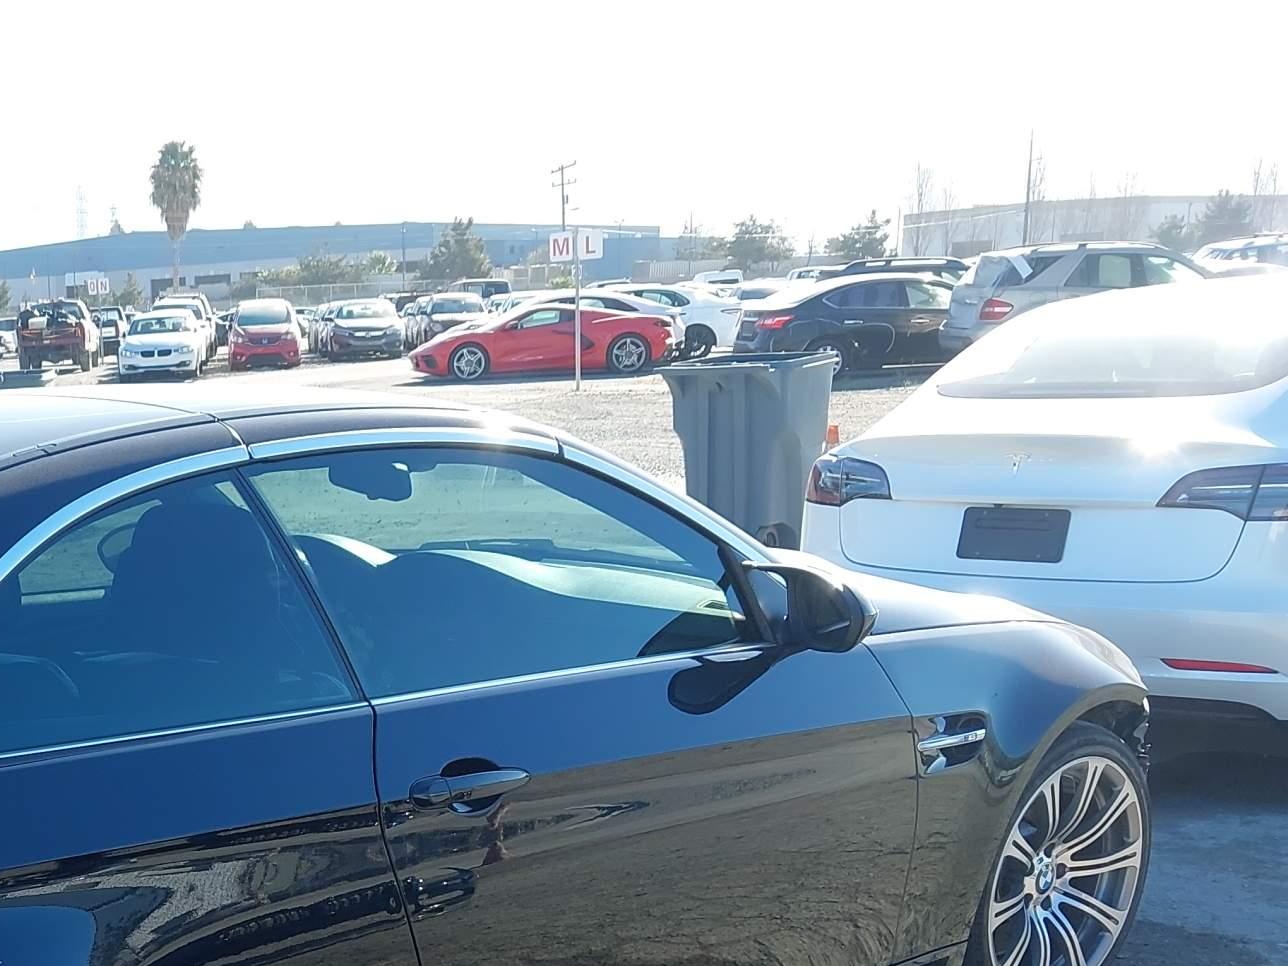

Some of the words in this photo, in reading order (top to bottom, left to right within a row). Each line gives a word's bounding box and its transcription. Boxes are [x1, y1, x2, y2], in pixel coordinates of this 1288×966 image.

[552, 237, 570, 257] M
[585, 235, 596, 255] L
[100, 280, 107, 291] N
